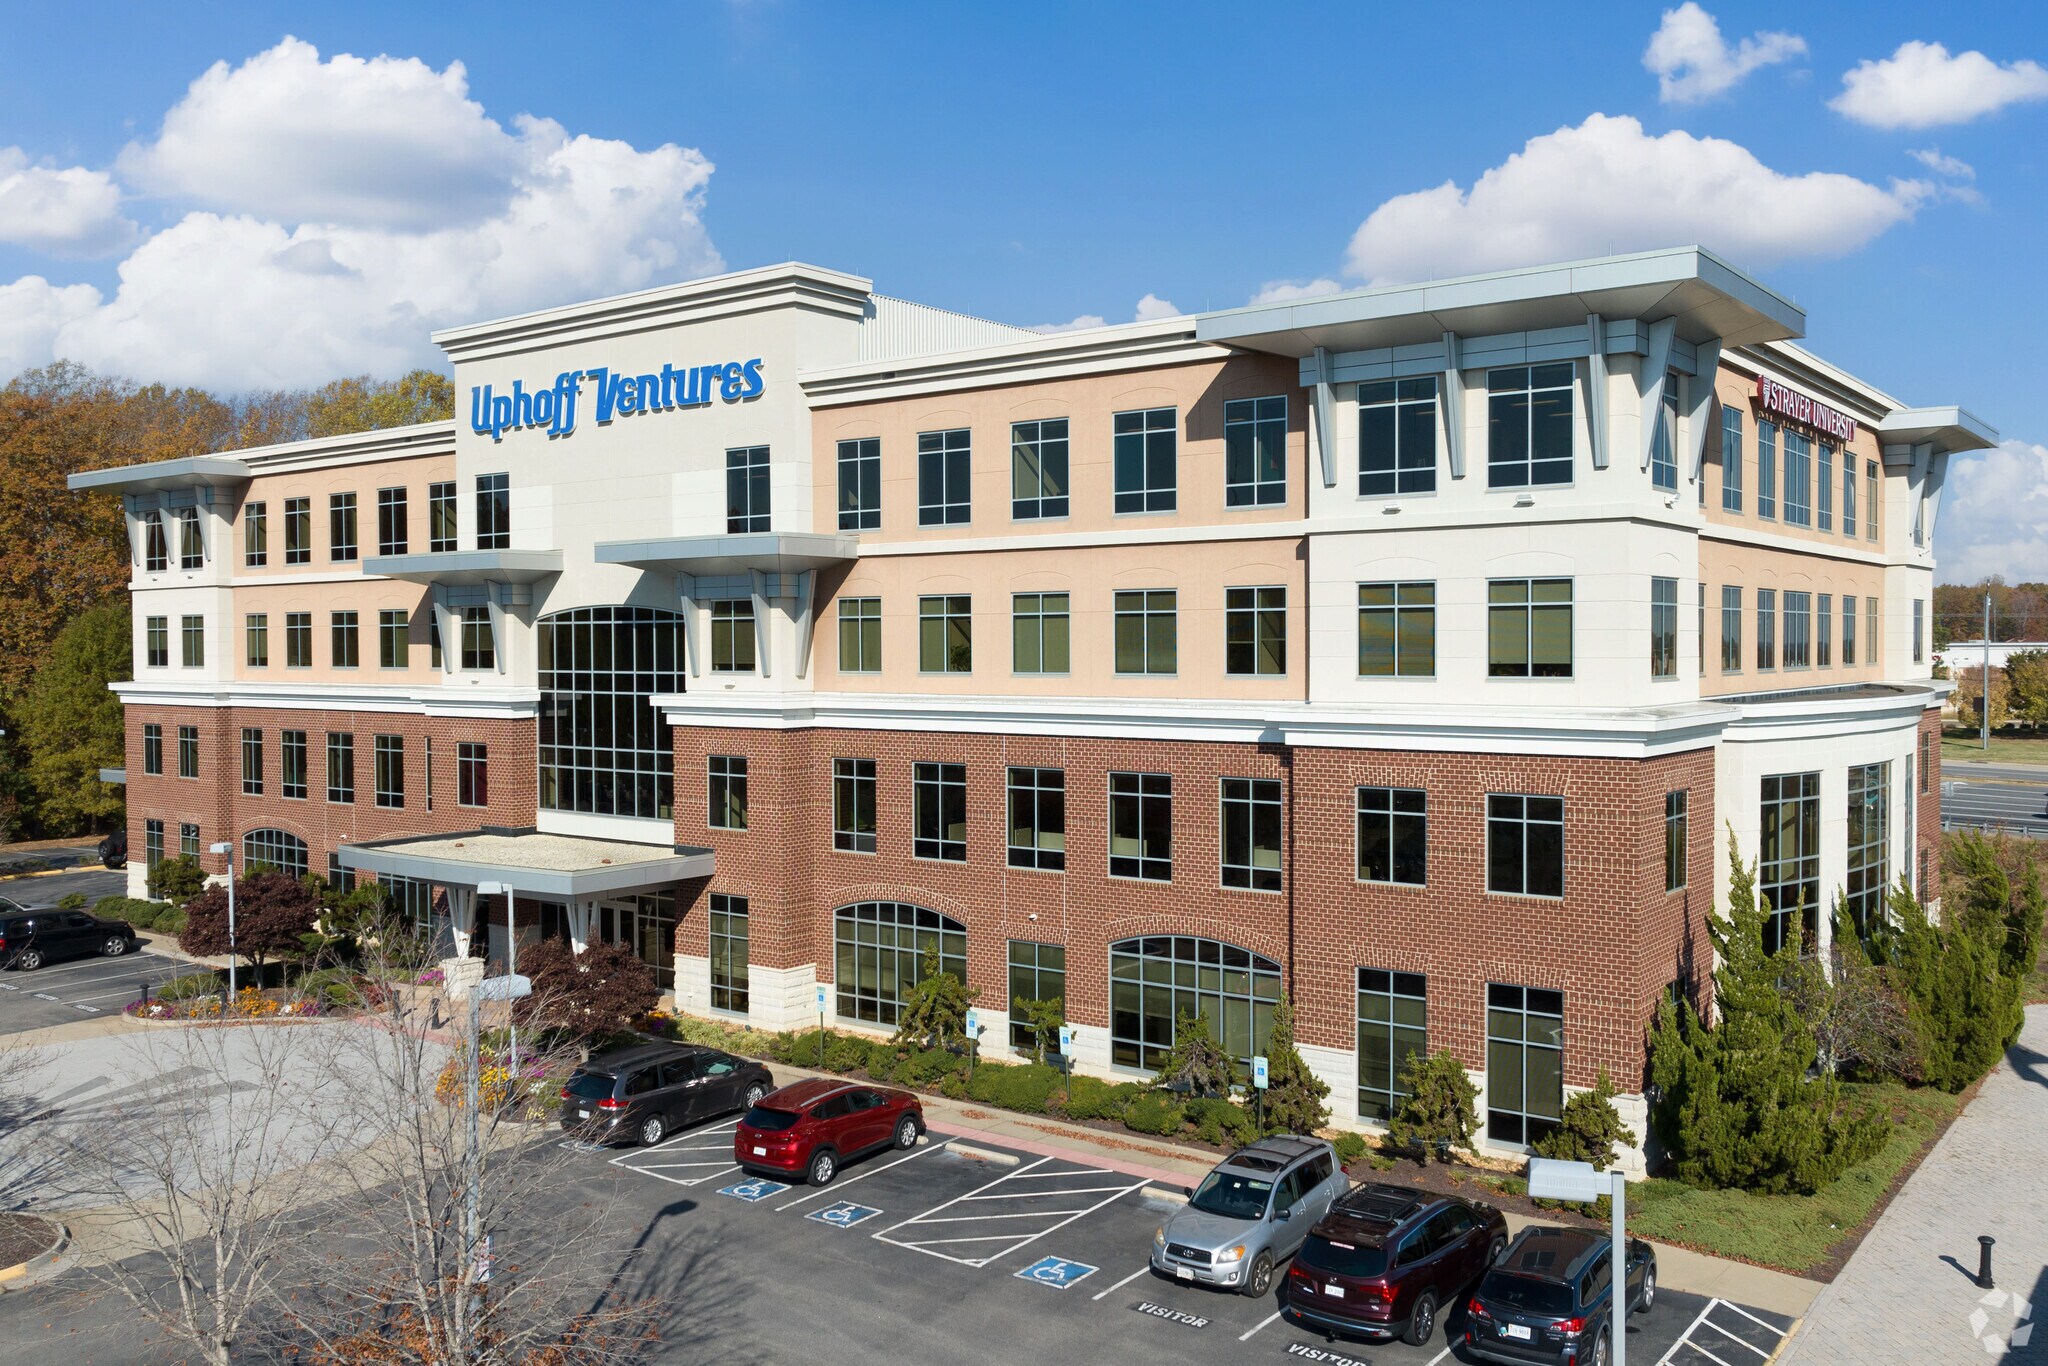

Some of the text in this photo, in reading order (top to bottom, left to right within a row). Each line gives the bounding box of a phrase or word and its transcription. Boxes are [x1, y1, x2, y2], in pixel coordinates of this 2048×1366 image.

[471, 358, 765, 439] Uphoff Ventures
[1771, 383, 1858, 440] STRAYER UNIVERSITY
[1137, 1302, 1209, 1328] VISITOR
